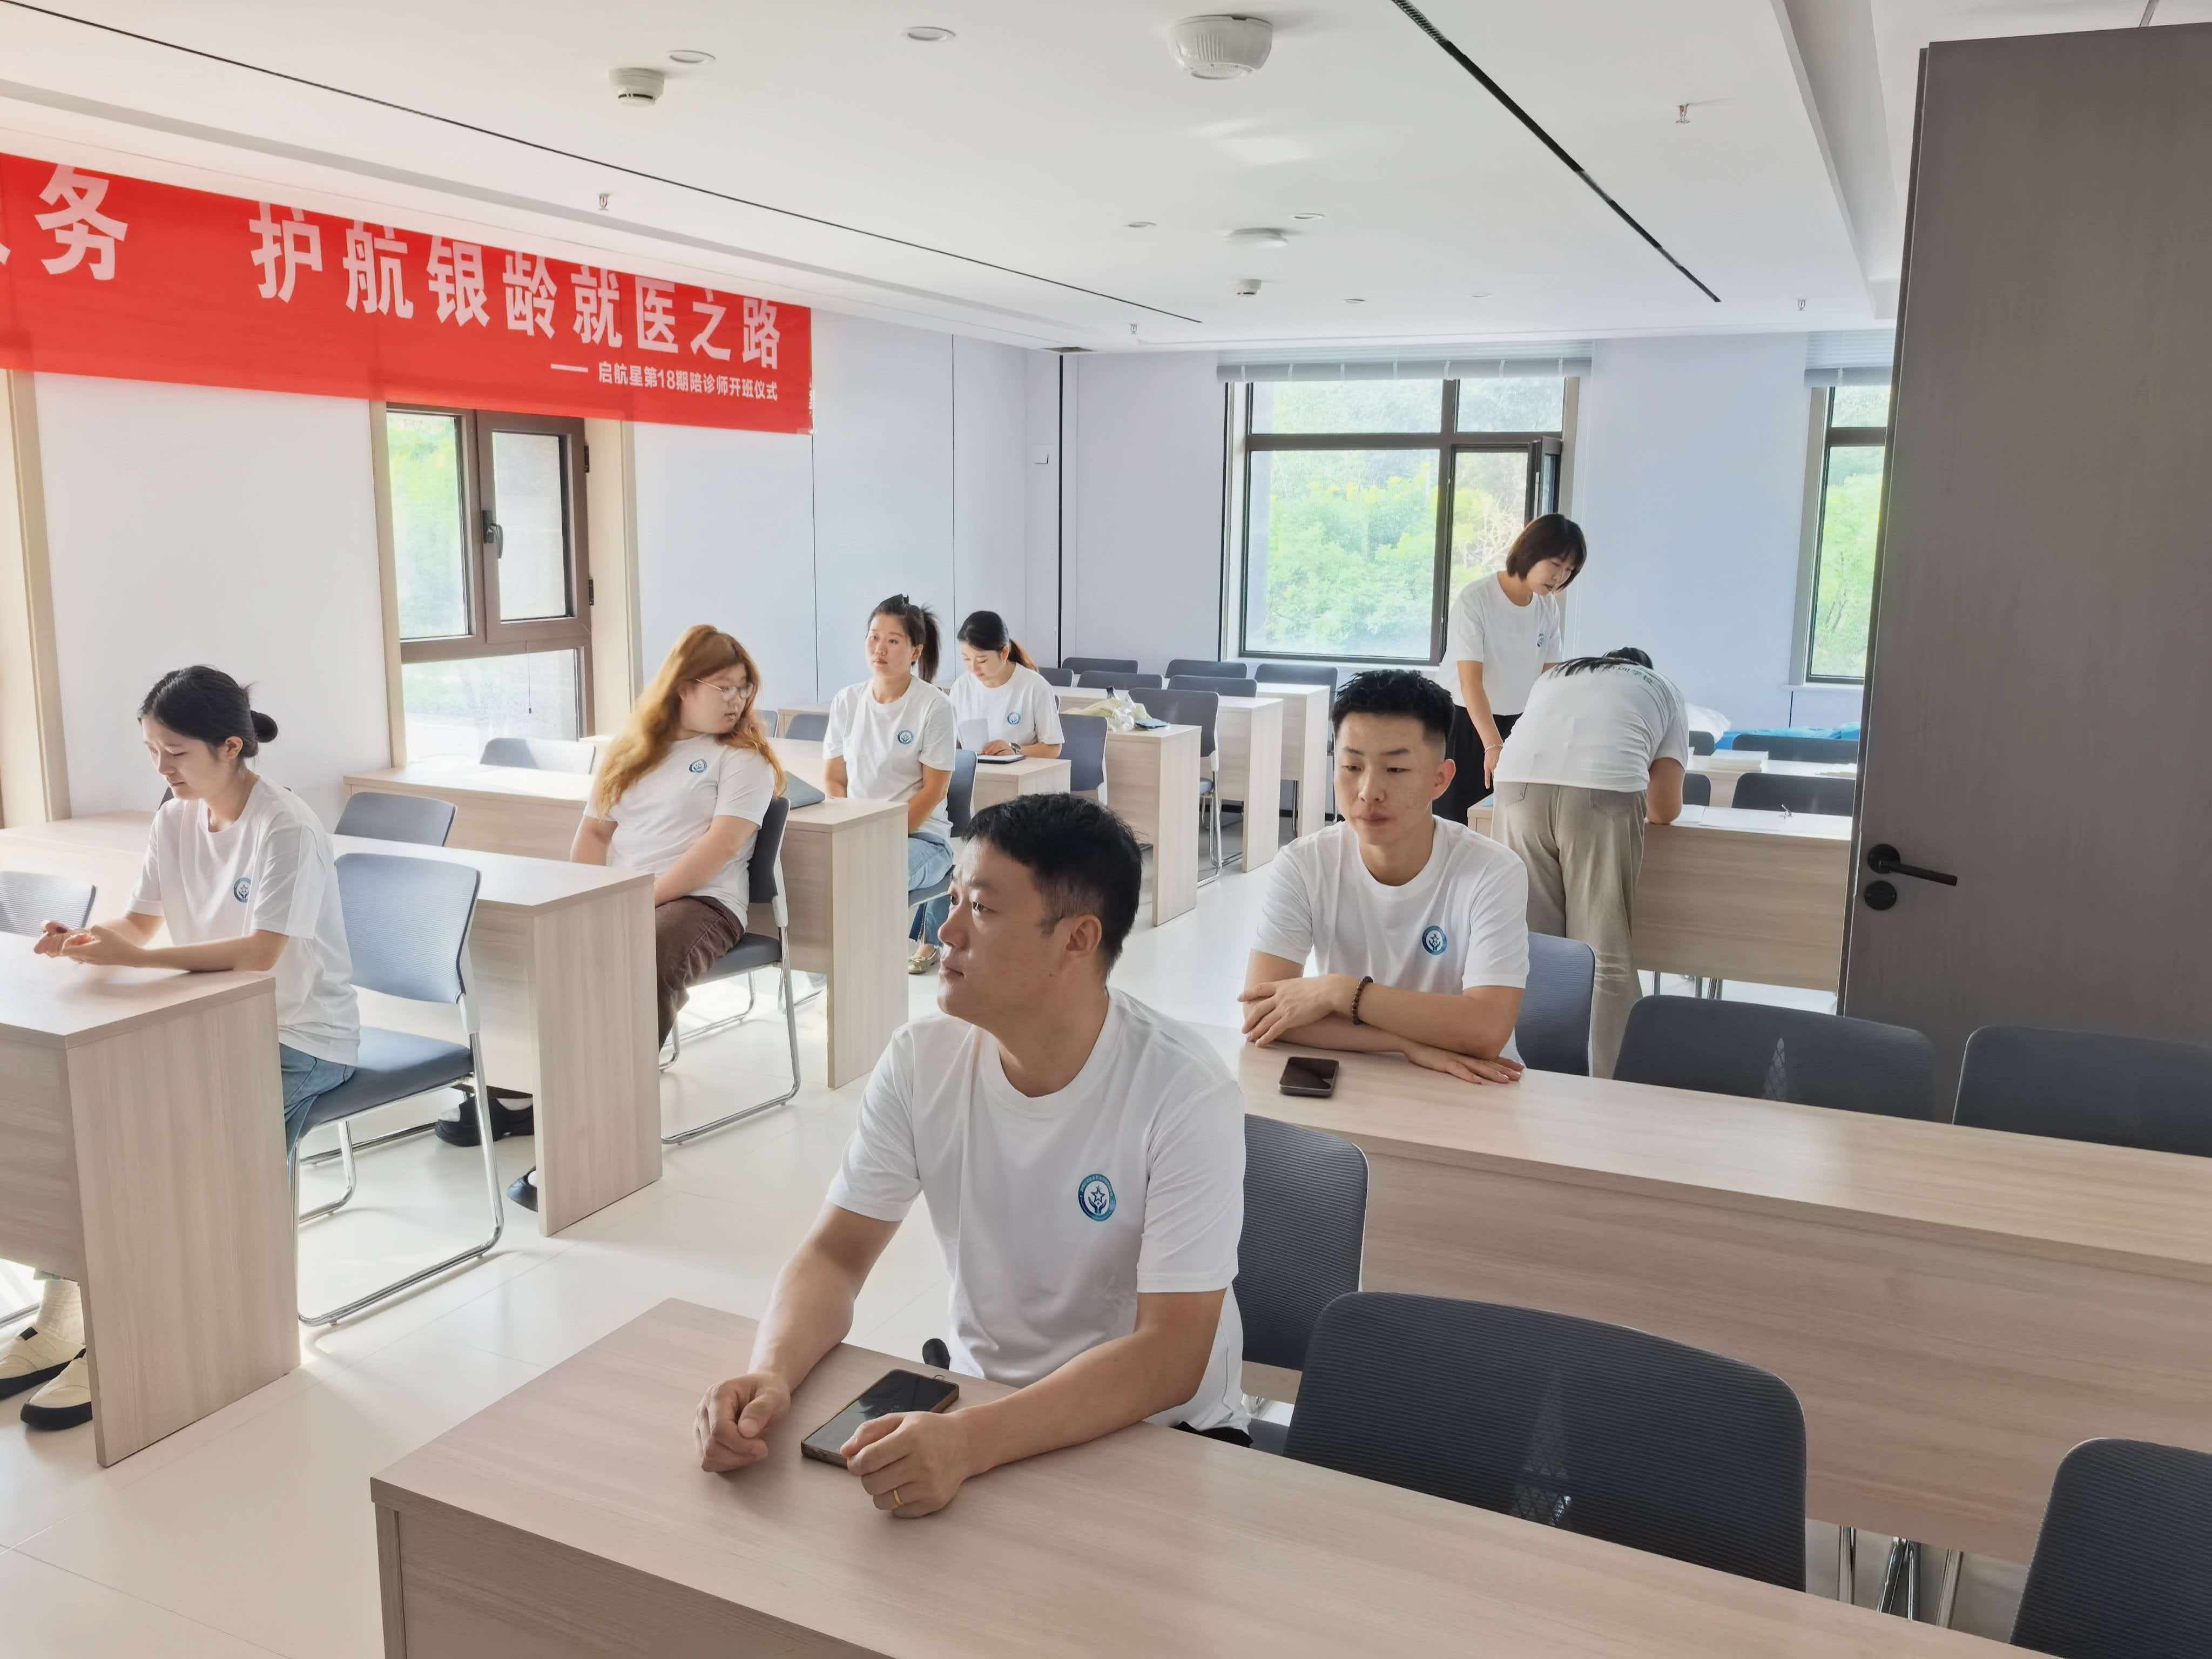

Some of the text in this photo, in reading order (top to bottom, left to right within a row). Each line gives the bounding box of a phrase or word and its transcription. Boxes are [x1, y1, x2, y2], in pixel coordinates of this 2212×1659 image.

[0, 164, 781, 369] 务 护航银龄就医之路
